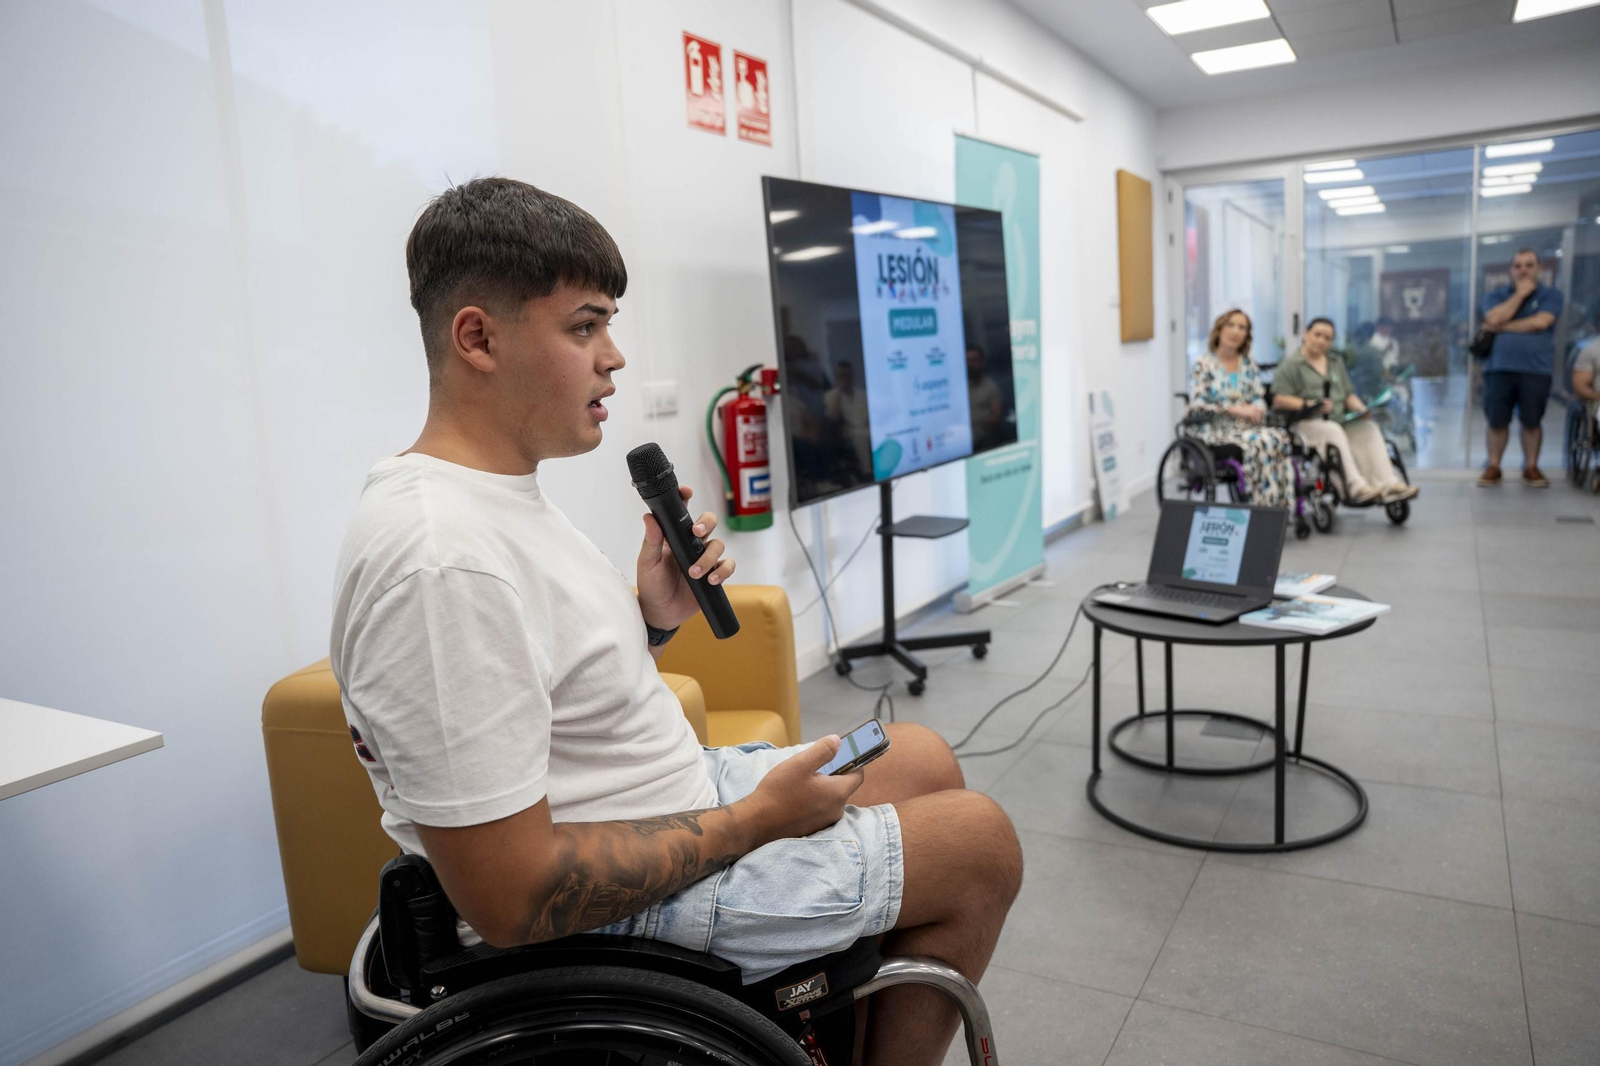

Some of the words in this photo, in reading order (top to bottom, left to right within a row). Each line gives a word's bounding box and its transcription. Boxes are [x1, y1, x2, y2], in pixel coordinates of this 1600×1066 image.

[877, 247, 939, 285] LESIÓN
[789, 980, 812, 998] JAY
[377, 1011, 470, 1066] WALBE
